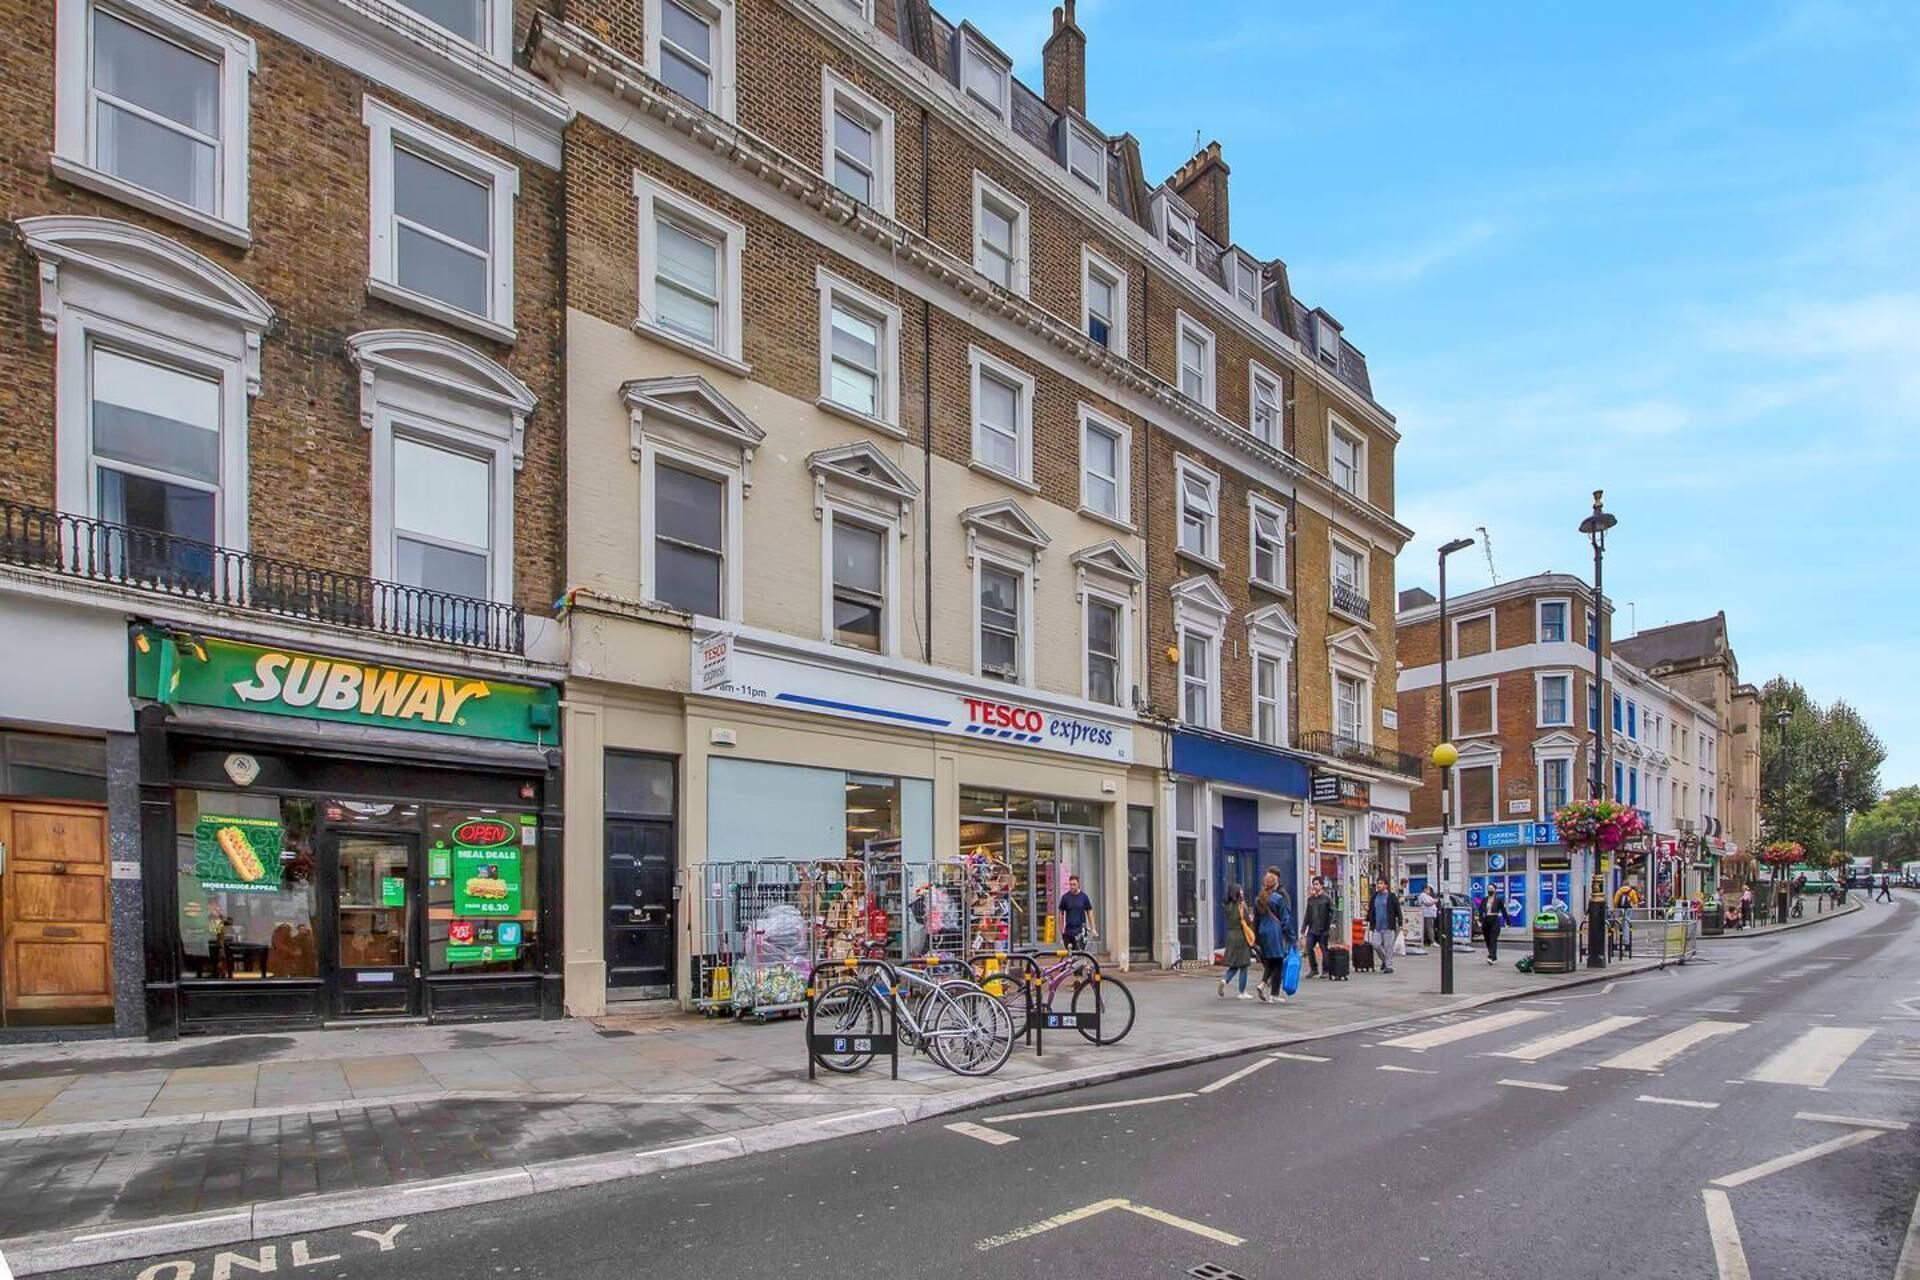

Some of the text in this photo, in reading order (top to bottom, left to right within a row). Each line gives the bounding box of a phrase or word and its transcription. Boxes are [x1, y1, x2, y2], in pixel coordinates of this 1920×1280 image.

[704, 643, 726, 662] TESCO
[703, 665, 726, 684] express
[232, 653, 491, 724] SUBWAY
[741, 684, 767, 698] 11pm
[962, 697, 1113, 746] TESCO express
[460, 824, 506, 842] OPEN
[458, 850, 516, 860] MEAL DEALS
[249, 884, 278, 892] APPEAL
[482, 903, 509, 912] £6.20
[136, 1223, 408, 1280] ONLY
